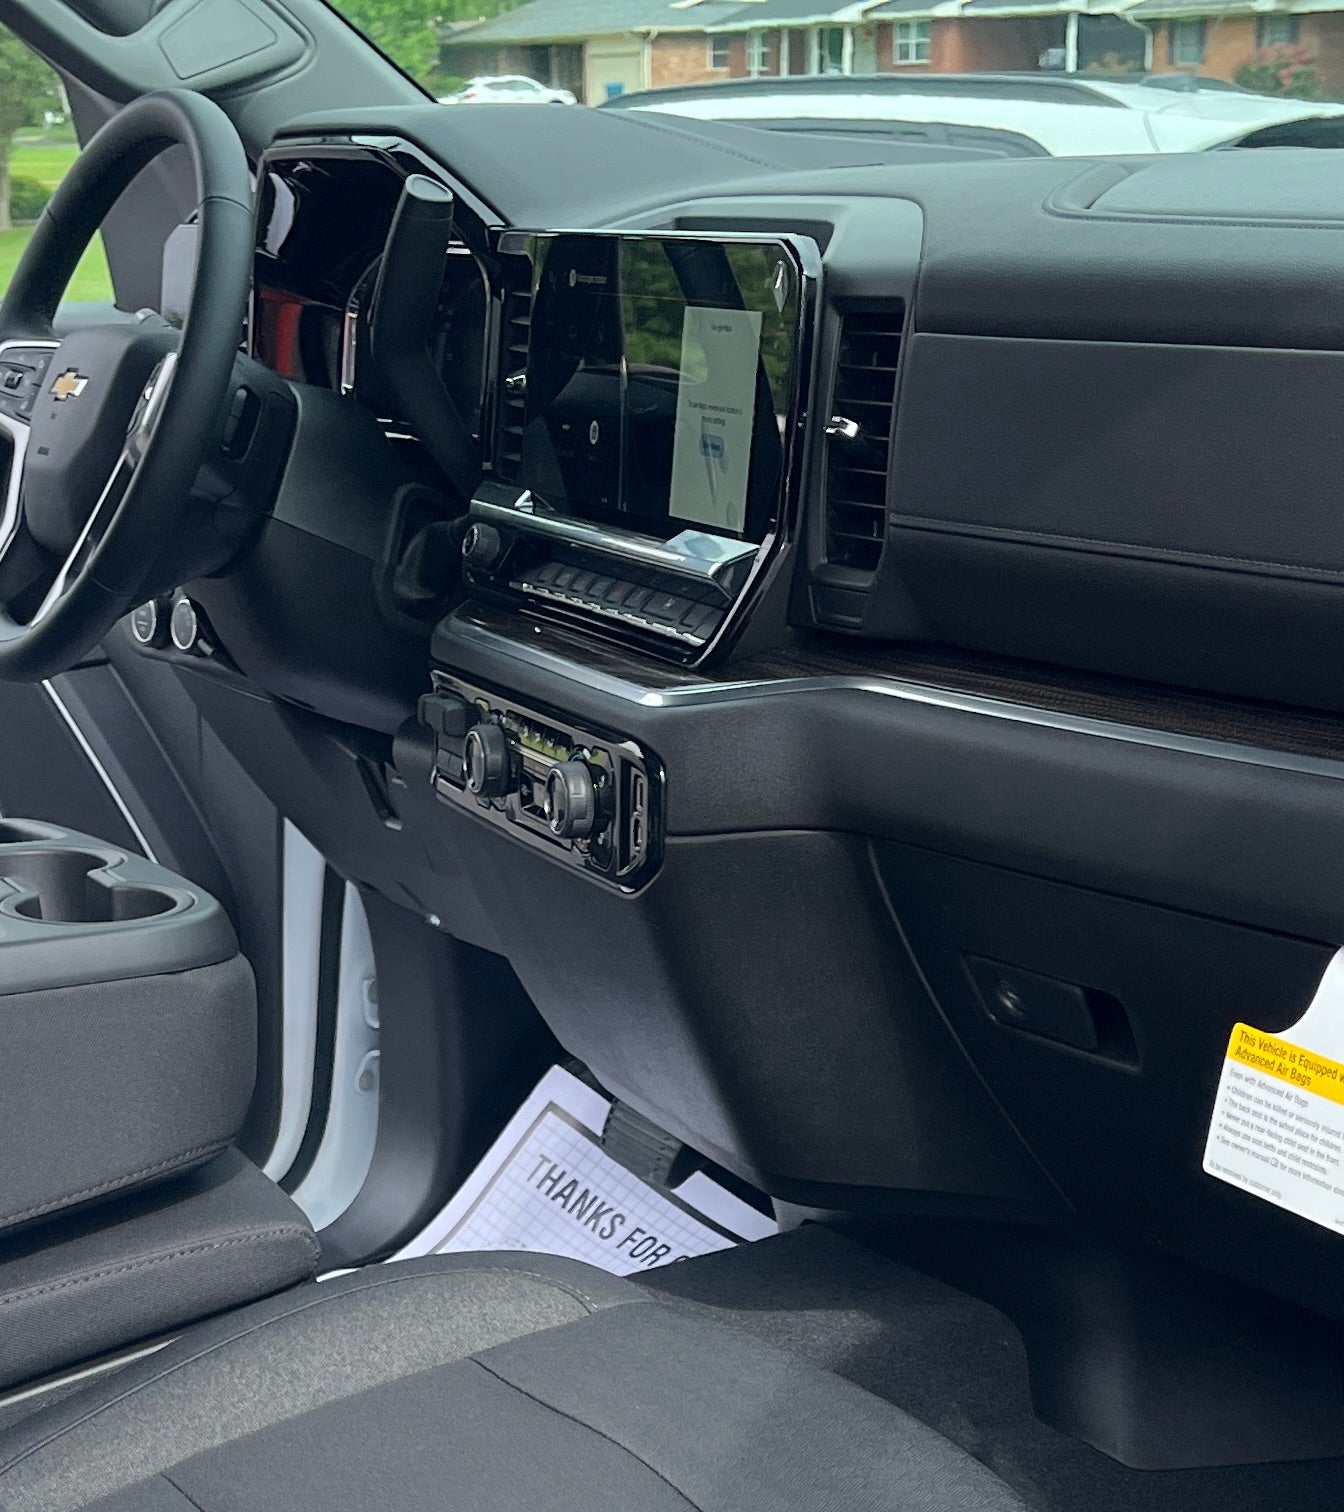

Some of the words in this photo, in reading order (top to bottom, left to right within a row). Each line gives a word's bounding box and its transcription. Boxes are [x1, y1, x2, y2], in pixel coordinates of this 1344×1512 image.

[1234, 1045, 1275, 1071] Advanced
[1275, 1062, 1289, 1076] Air
[1290, 1067, 1312, 1087] Bags
[1239, 1029, 1256, 1048] This
[1258, 1037, 1287, 1060] Vehicle
[1288, 1050, 1297, 1063] is
[1298, 1053, 1338, 1080] Equipped
[525, 1153, 626, 1240] THANKS
[617, 1226, 671, 1266] FOR
